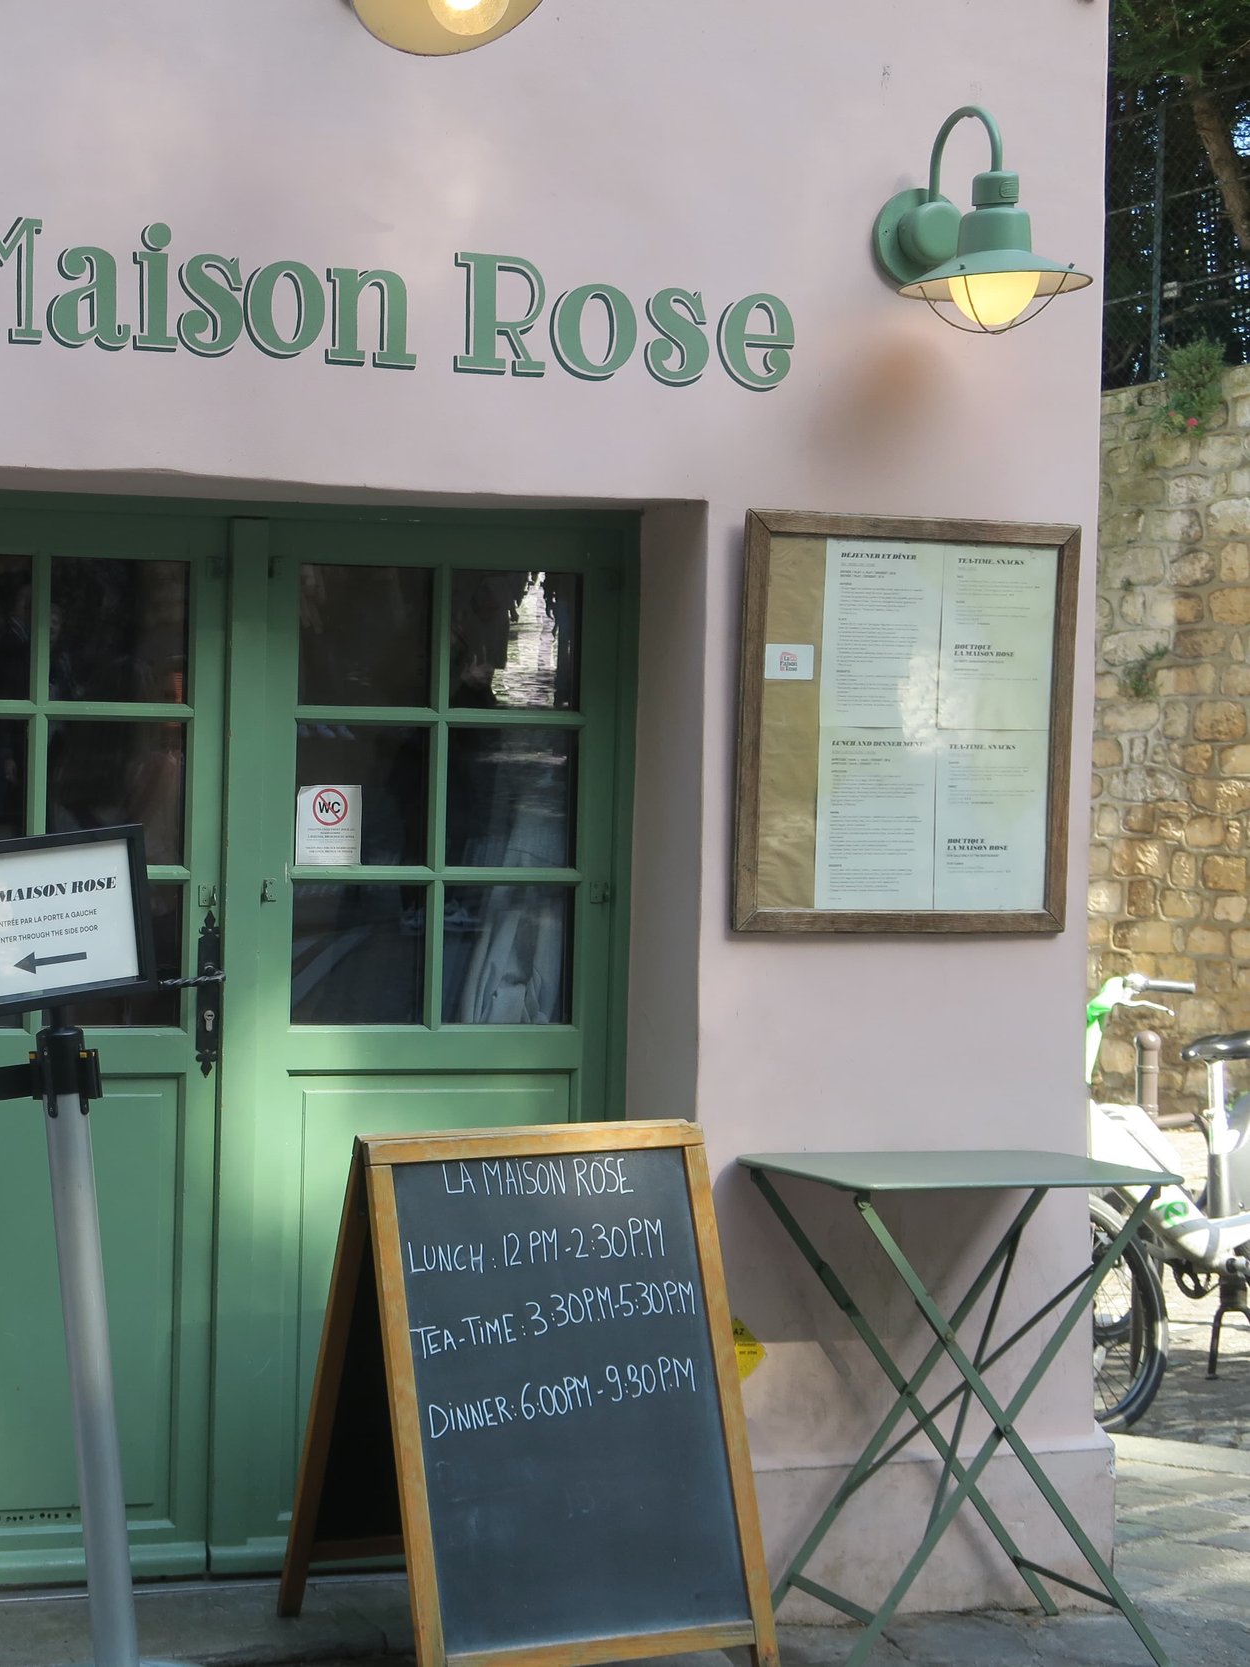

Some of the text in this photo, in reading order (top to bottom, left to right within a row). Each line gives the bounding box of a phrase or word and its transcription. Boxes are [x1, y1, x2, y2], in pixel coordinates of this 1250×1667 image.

[453, 251, 796, 392] Rose
[318, 801, 341, 814] WC
[71, 876, 117, 894] ROSE
[20, 916, 33, 925] PAR
[34, 915, 42, 924] LA
[43, 912, 64, 922] PORTE
[65, 911, 70, 920] A
[71, 908, 98, 918] GAUCHE
[18, 931, 50, 942] THROUGH
[51, 928, 64, 938] THE
[64, 926, 78, 936] SIDE
[80, 924, 98, 934] DOOR
[442, 1162, 476, 1195] LA
[573, 1157, 634, 1196] ROSE
